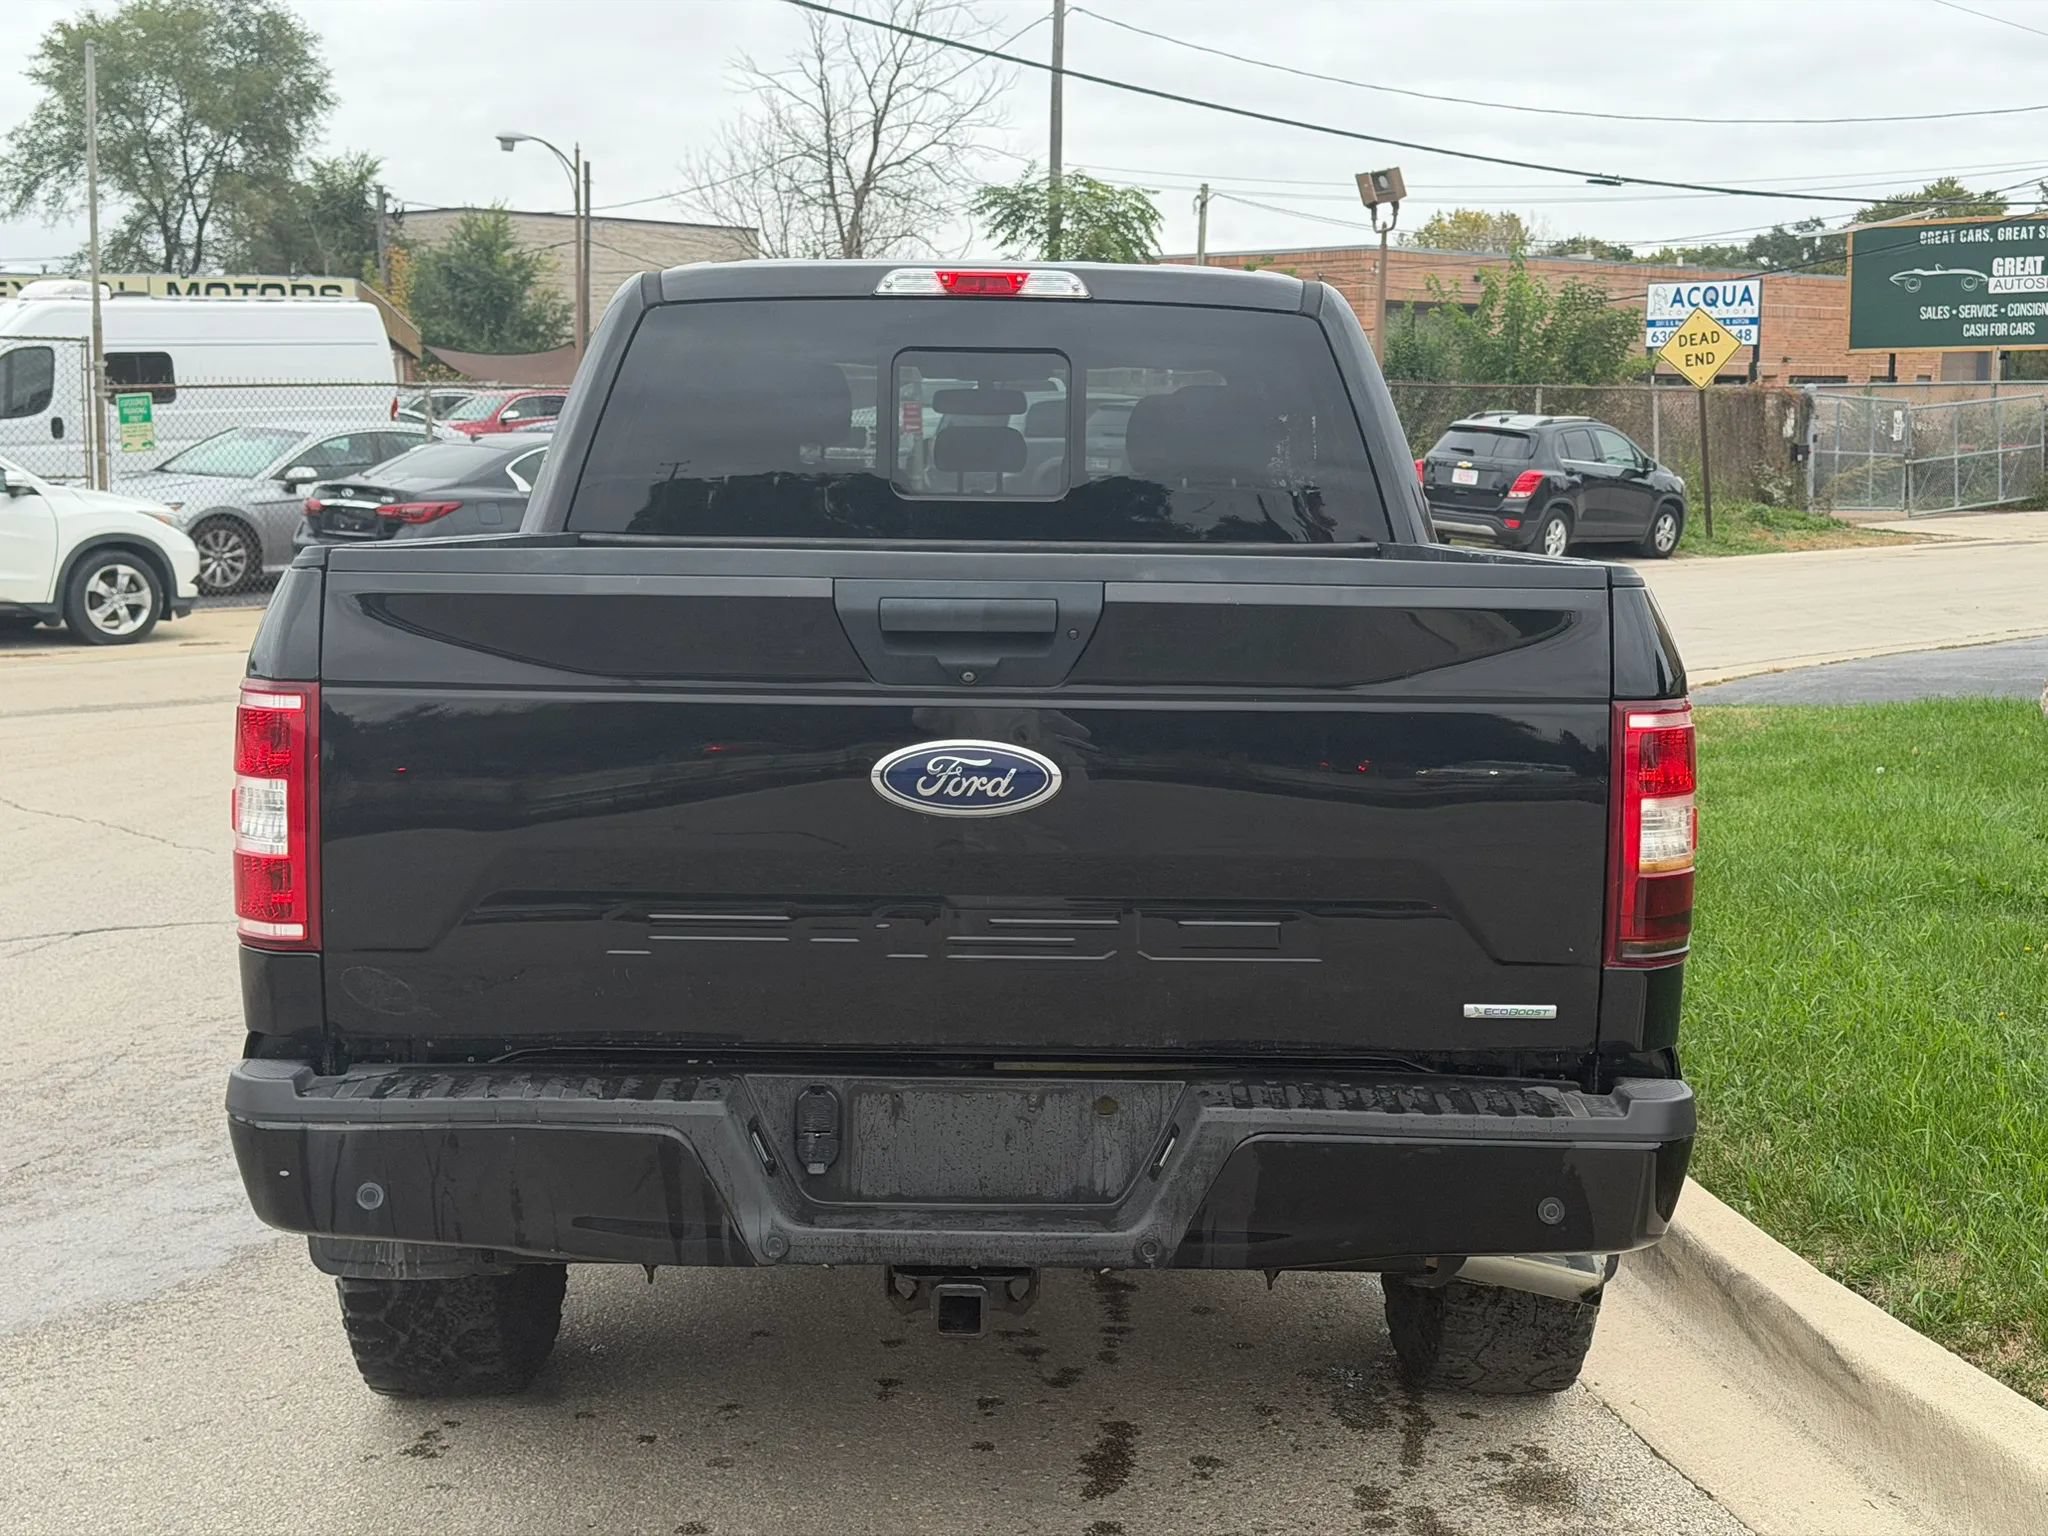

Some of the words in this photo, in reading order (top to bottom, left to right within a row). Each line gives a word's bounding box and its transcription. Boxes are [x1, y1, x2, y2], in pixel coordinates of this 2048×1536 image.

[1920, 230, 1956, 245] GREAT
[1960, 229, 1994, 243] CARS,
[1998, 226, 2035, 241] GREAT
[1992, 256, 2045, 276] GREAT
[1993, 277, 2048, 290] AUTOS
[1670, 285, 1754, 308] ACQUA
[1920, 306, 1950, 320] SALES
[1958, 304, 1998, 318] SERVICE
[1963, 324, 1988, 337] CASH
[1989, 323, 2008, 336] FOR
[2009, 322, 2036, 336] CARS
[1678, 330, 1721, 347] DEAD
[1685, 351, 1716, 367] END
[916, 756, 1016, 797] Ford
[1484, 1008, 1550, 1016] ECOBOOST
